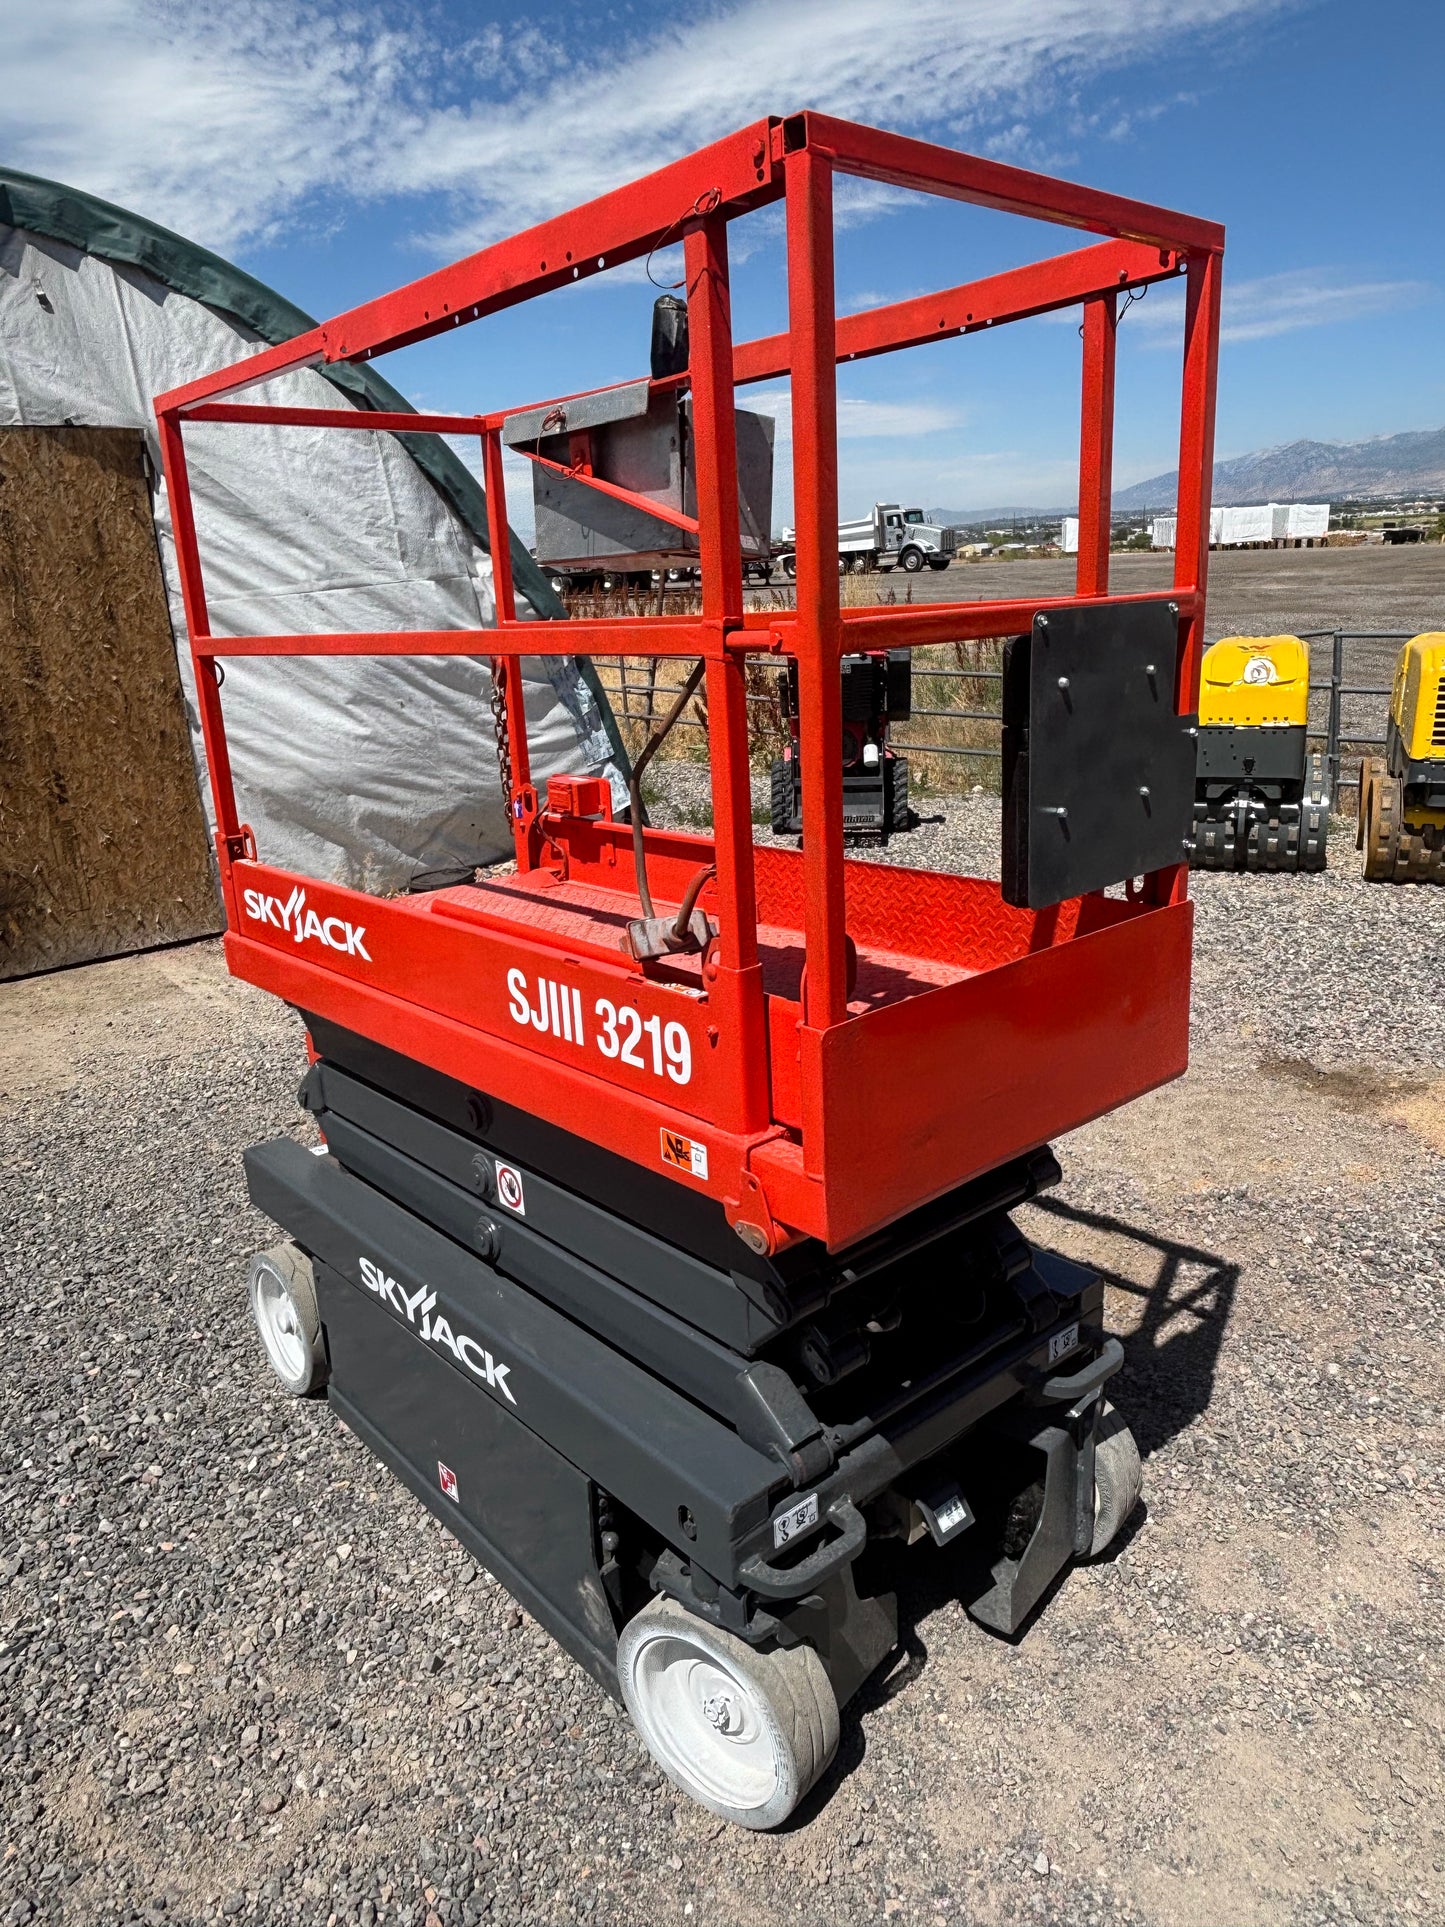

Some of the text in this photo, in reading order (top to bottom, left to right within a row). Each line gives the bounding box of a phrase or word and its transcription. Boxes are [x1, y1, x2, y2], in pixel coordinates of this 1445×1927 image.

[243, 885, 373, 962] SKYJACK
[507, 967, 692, 1086] SJIII 3219
[357, 1255, 518, 1406] SKYJACK
